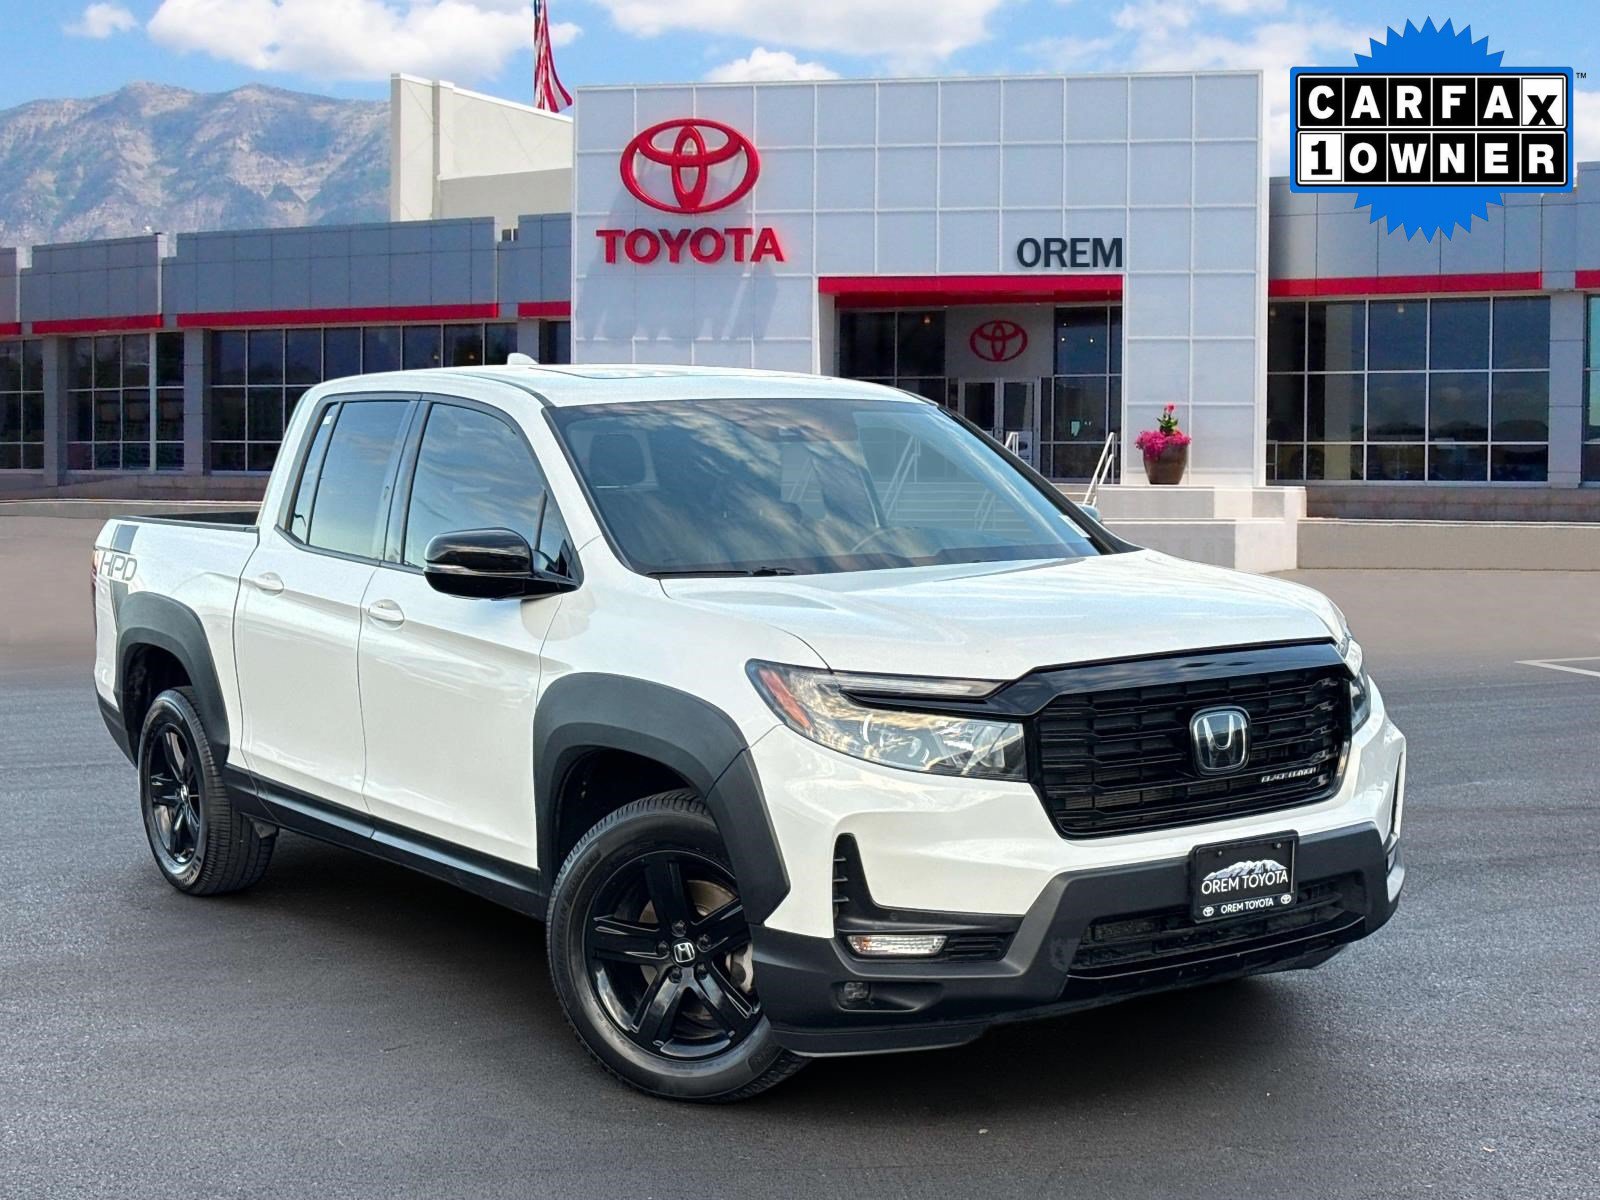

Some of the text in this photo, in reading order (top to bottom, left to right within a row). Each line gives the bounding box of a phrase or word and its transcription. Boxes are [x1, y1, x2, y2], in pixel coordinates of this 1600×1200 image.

[596, 227, 784, 264] TOYOTA
[1017, 237, 1122, 268] OREM
[99, 552, 138, 581] HPD
[1201, 870, 1288, 895] OREM TOYOTA
[1220, 898, 1274, 914] OREM TOYOTA
